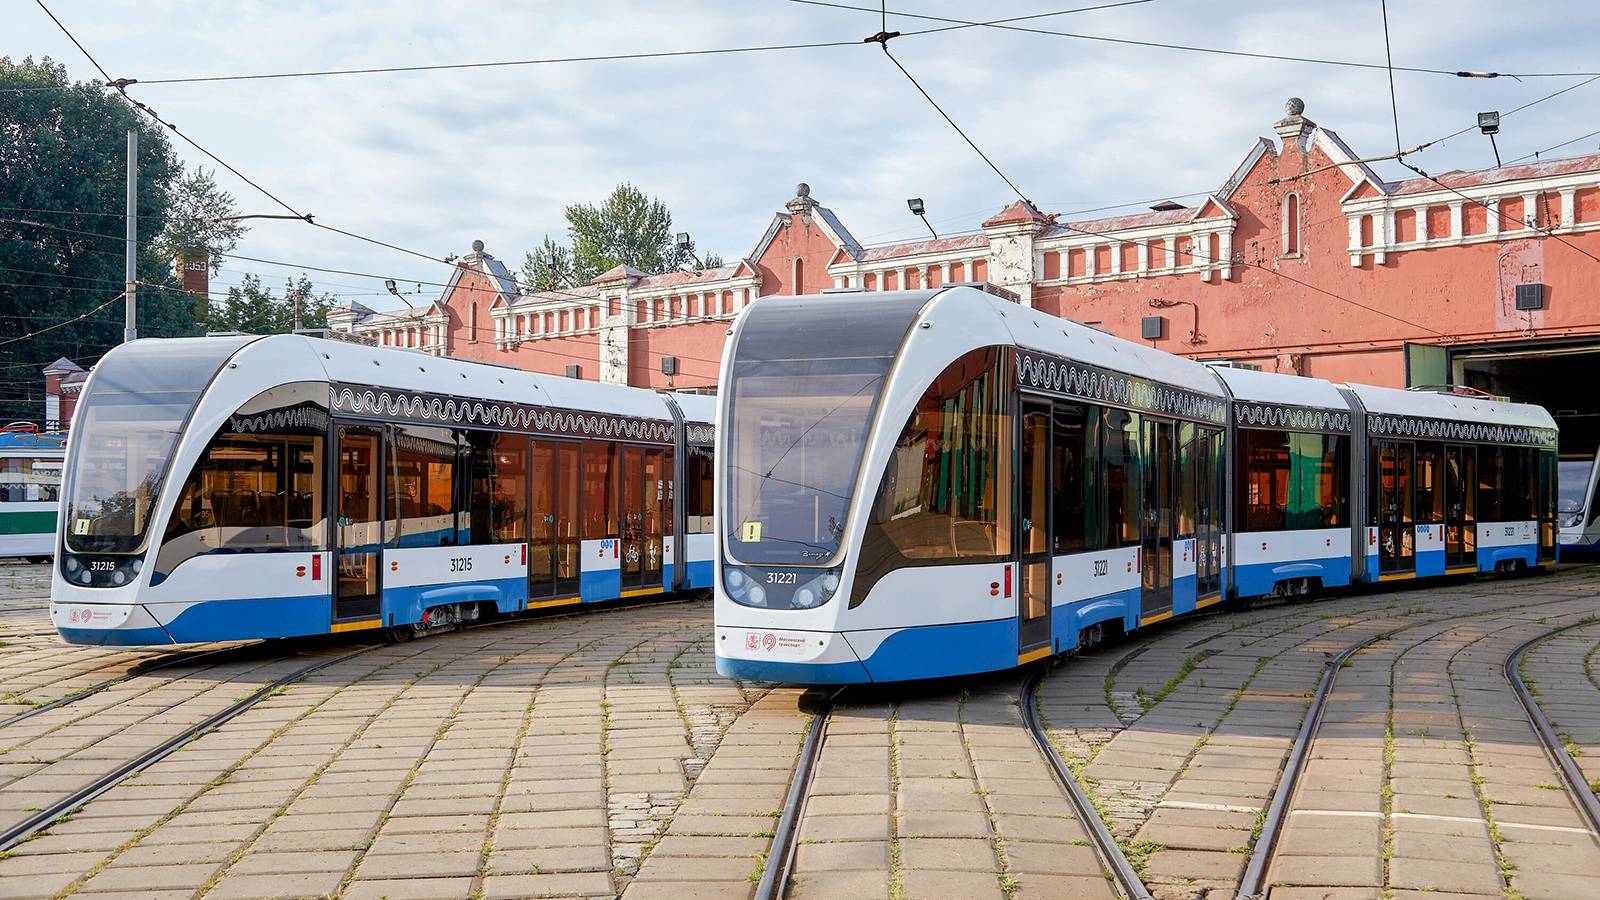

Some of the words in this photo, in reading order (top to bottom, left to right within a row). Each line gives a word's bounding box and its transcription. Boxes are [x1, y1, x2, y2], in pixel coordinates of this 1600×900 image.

[90, 561, 116, 571] 31215
[450, 557, 473, 572] 31215
[1093, 559, 1108, 578] 31221
[766, 572, 797, 584] 31221
